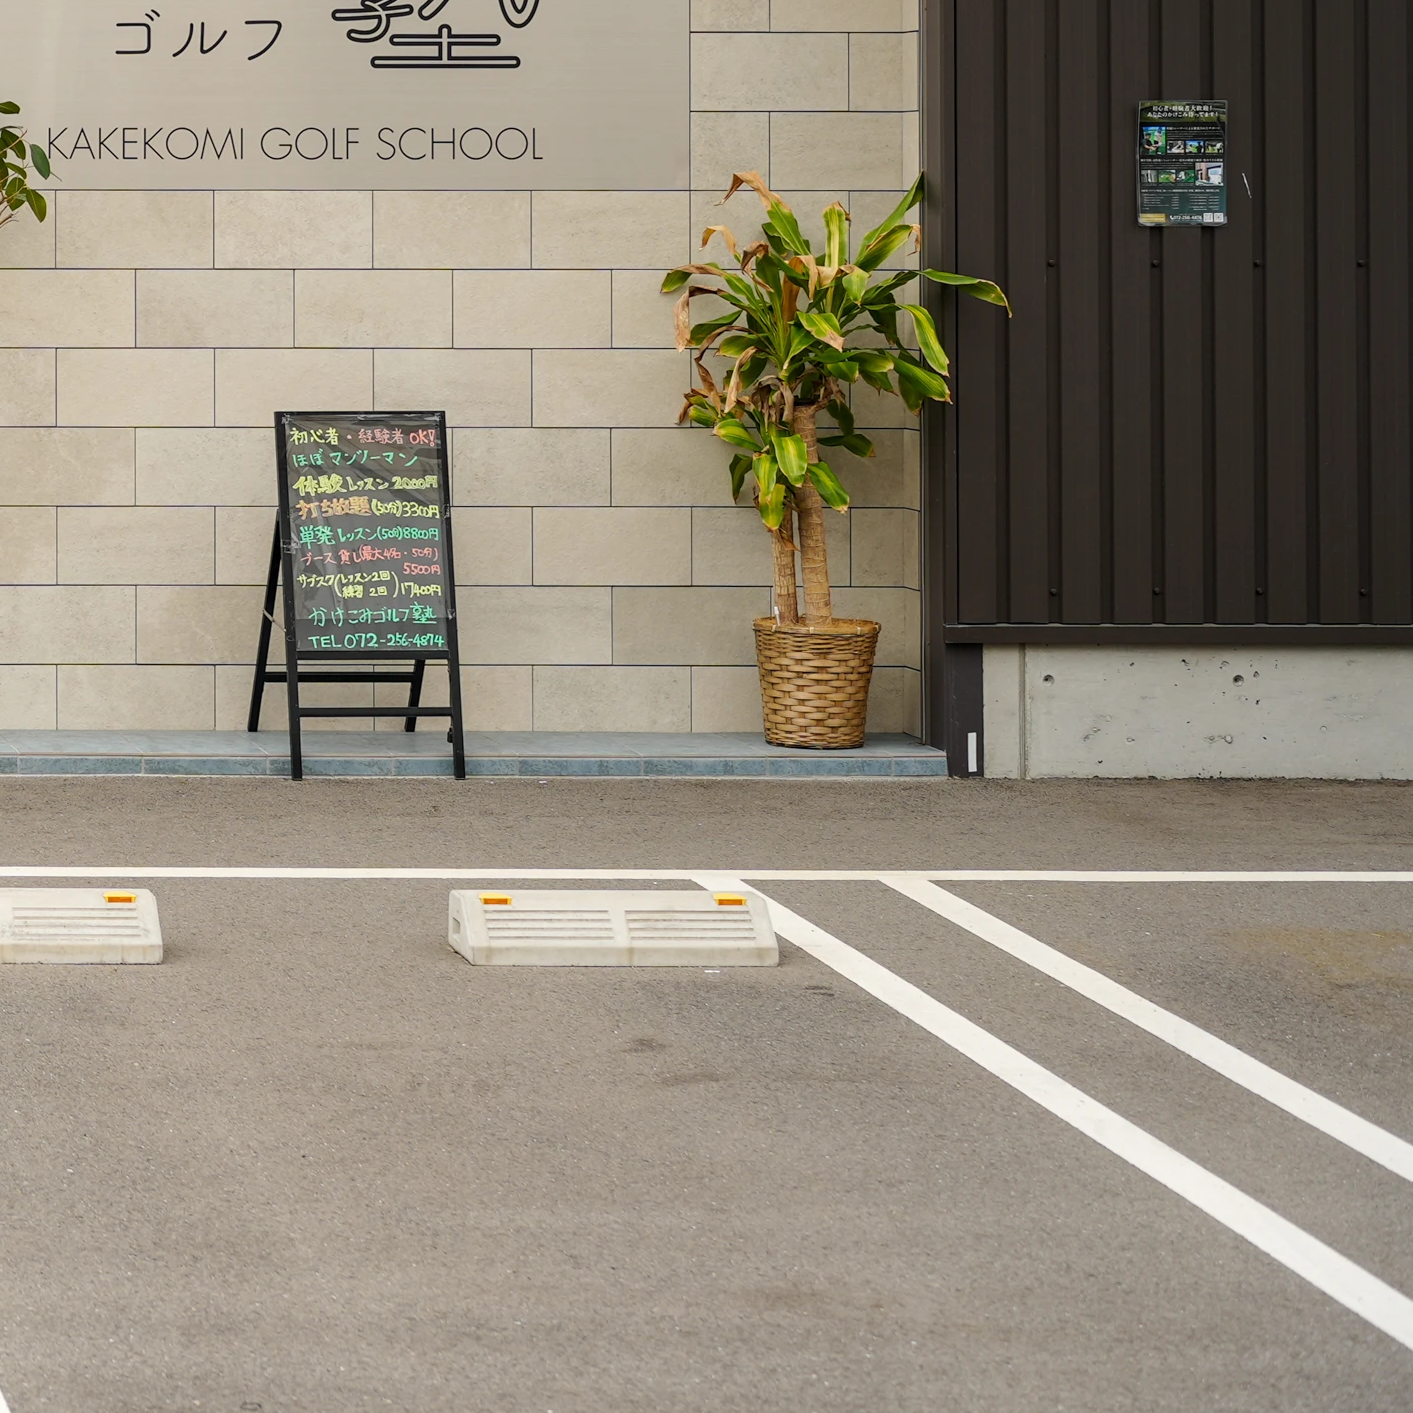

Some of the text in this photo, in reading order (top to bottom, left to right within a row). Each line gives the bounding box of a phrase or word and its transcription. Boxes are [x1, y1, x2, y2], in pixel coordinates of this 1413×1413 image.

[114, 9, 284, 61] ゴルフ
[46, 126, 544, 162] KAKEKOMI GOLF SCHOOL
[402, 562, 442, 576] 5500円
[308, 632, 445, 649] TEL 072-256-4874
